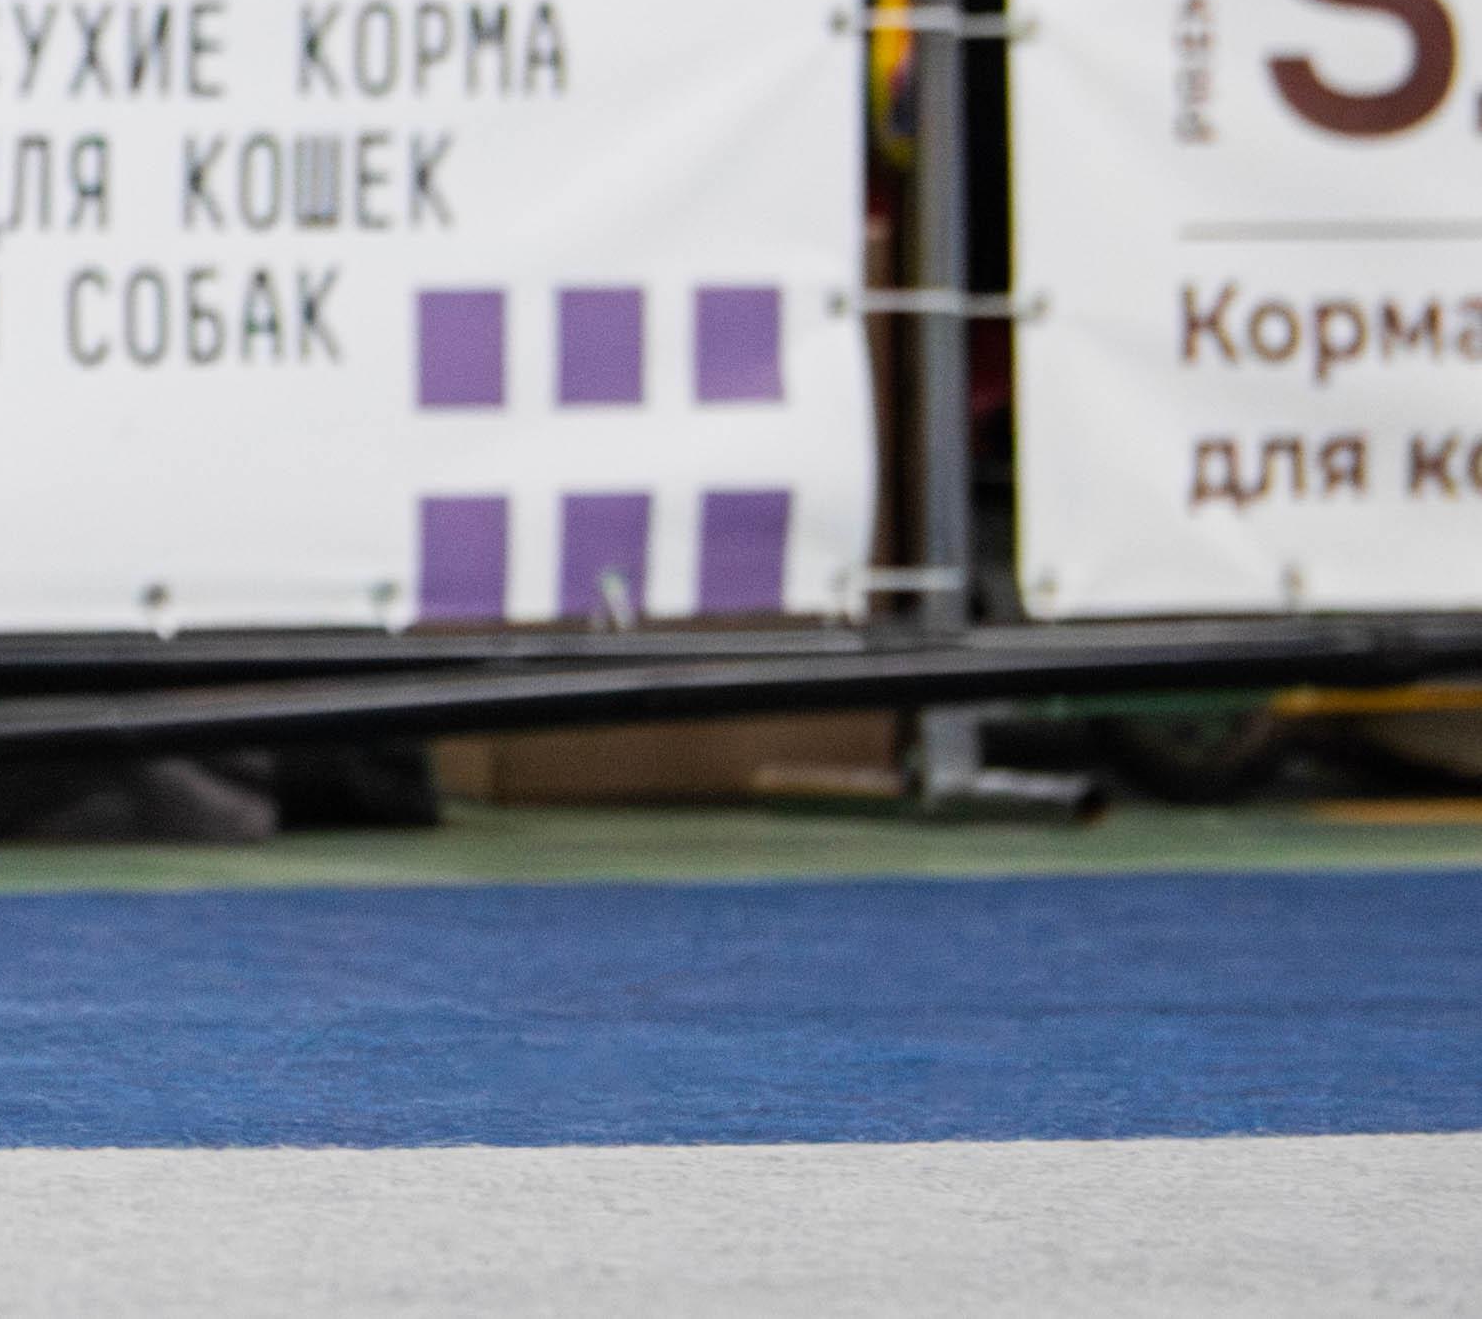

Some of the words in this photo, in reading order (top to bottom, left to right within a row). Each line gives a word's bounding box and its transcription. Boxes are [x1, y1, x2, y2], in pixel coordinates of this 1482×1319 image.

[295, 0, 570, 97] КОРМА
[181, 133, 456, 231] КОШЕК
[64, 266, 343, 367] СОБАК
[1189, 435, 1369, 514] для
